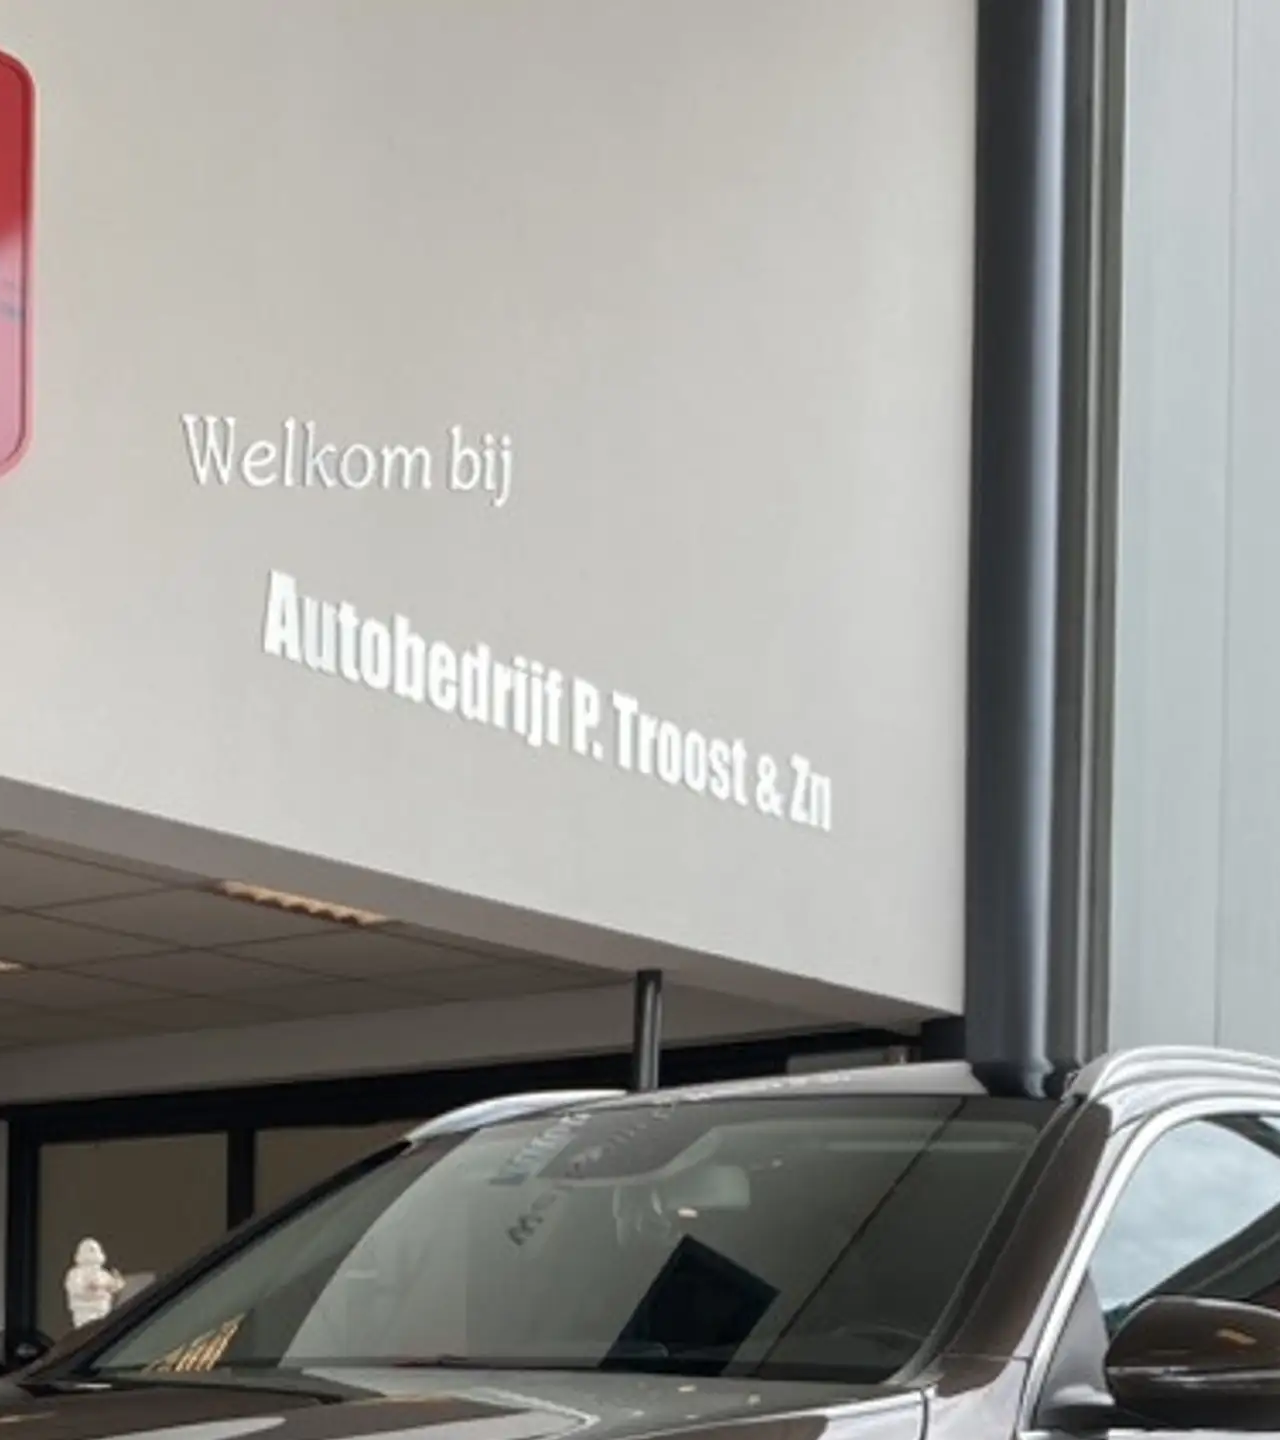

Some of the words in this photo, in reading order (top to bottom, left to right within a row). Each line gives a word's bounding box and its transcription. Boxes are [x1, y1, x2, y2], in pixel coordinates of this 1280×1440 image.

[180, 412, 432, 489] Welkom
[447, 424, 515, 507] bij
[263, 567, 564, 749] Autobedrijf
[571, 676, 605, 760] P.
[611, 688, 749, 808] Troost
[754, 751, 784, 818] &
[789, 752, 833, 832] Zn
